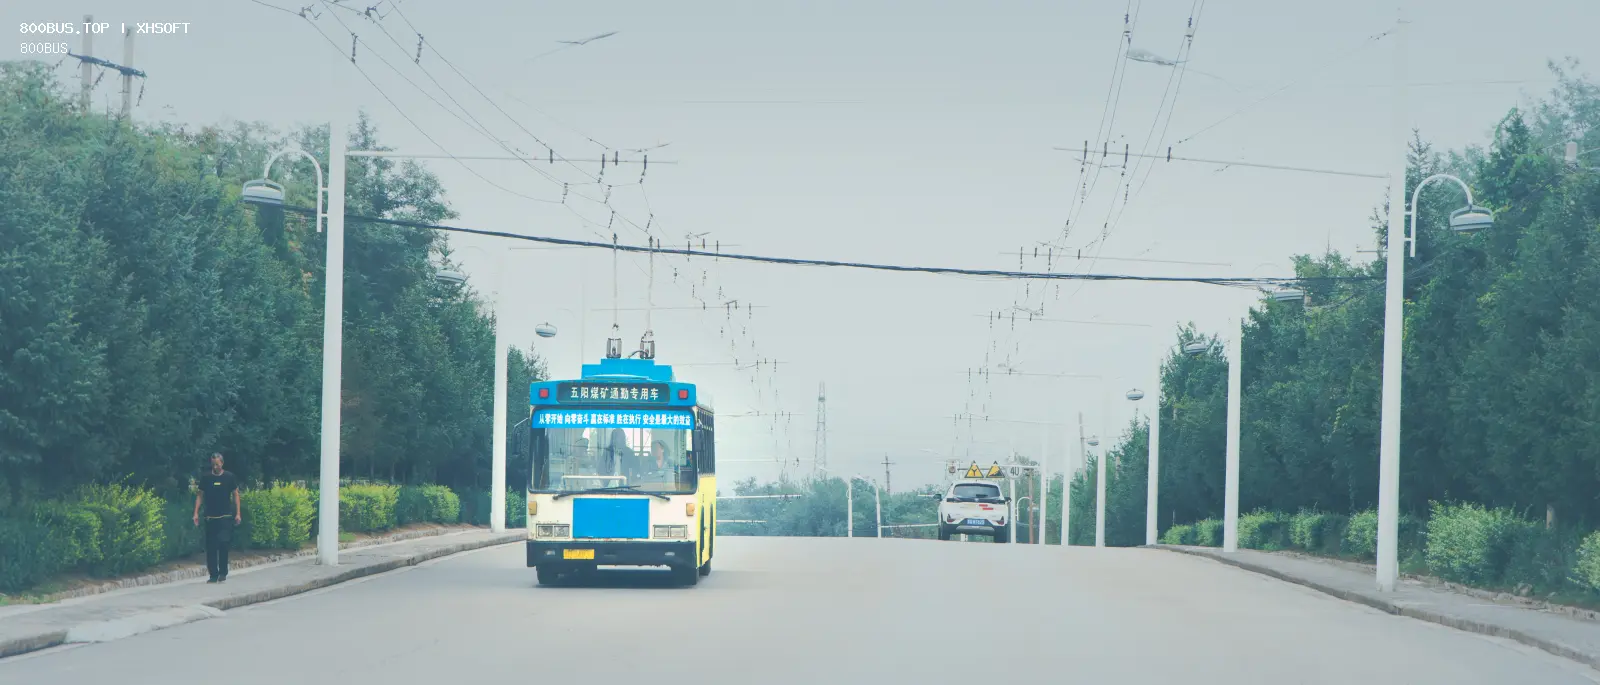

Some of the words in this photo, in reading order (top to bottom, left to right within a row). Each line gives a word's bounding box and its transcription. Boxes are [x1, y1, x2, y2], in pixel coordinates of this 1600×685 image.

[570, 386, 660, 401] 五阳煤矿通勤专用车
[539, 413, 564, 425] 从零开始
[565, 413, 589, 425] 向零奋斗
[590, 413, 615, 425] 赢在标准
[616, 413, 641, 425] 胜在执行
[642, 413, 691, 426] 安全是最大的效益
[1010, 466, 1020, 477] 40
